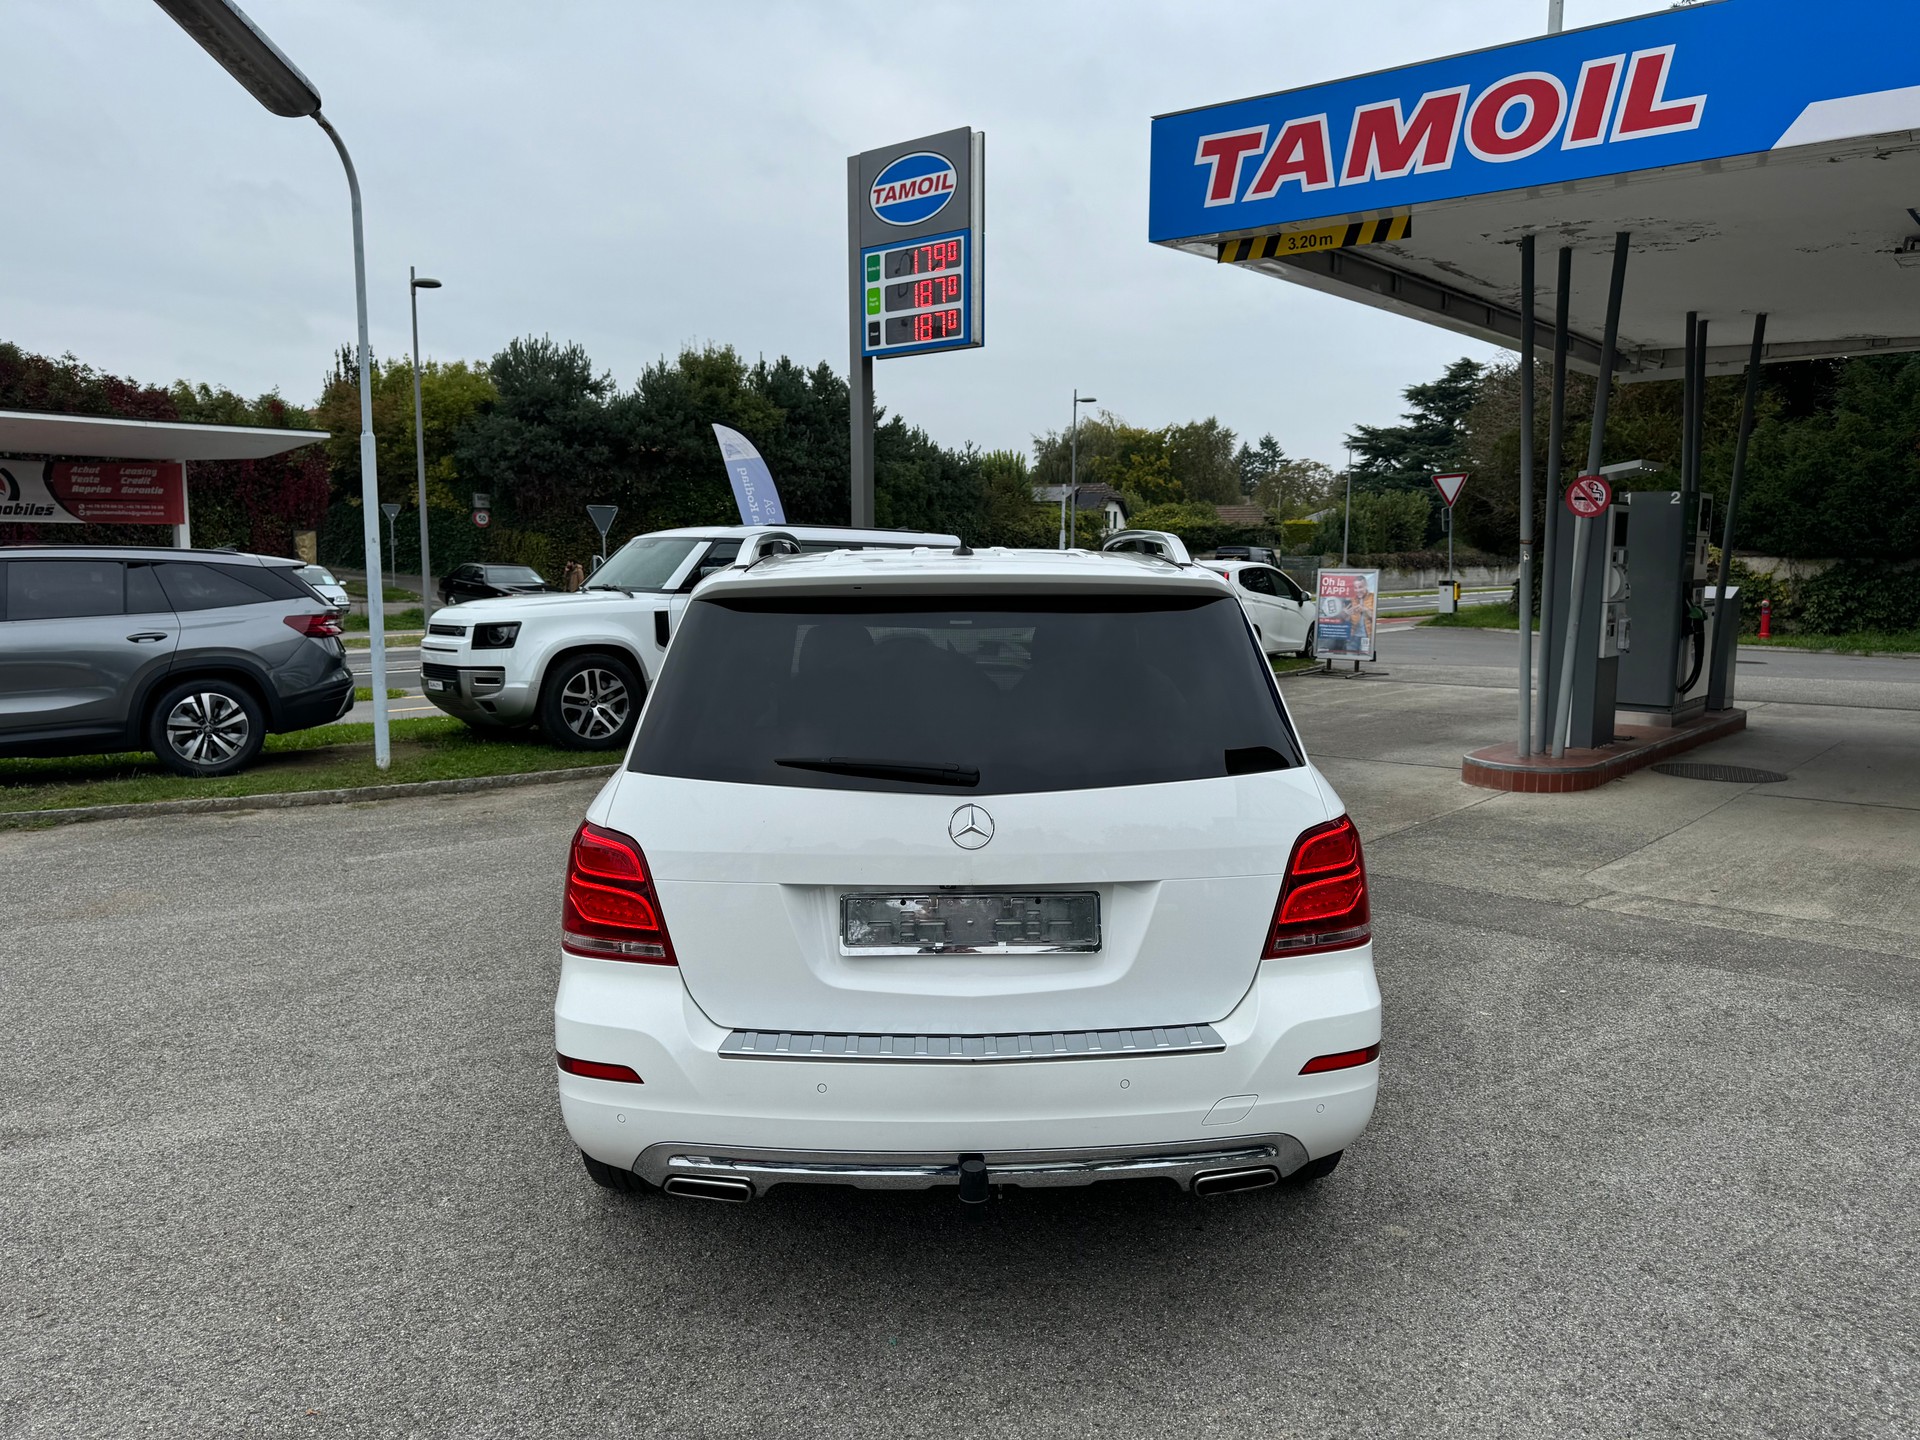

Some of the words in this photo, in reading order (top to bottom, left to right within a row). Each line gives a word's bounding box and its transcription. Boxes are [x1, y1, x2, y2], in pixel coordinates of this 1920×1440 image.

[1194, 44, 1707, 208] TAMOIL
[873, 173, 954, 205] TAMOIL
[1288, 234, 1317, 250] 3.20
[1319, 235, 1333, 246] m
[914, 241, 957, 275] 1790
[914, 275, 957, 308] 1870
[914, 309, 957, 341] 1870
[70, 466, 100, 474] Achat
[120, 468, 157, 477] Leasing
[71, 475, 100, 483] Vente
[72, 485, 112, 494] Reprise
[121, 486, 164, 495] Garantie
[1624, 492, 1632, 505] 1
[1670, 491, 1681, 504] 2
[0, 502, 55, 516] obiles
[1322, 577, 1335, 585] Oh
[1337, 578, 1345, 586] la
